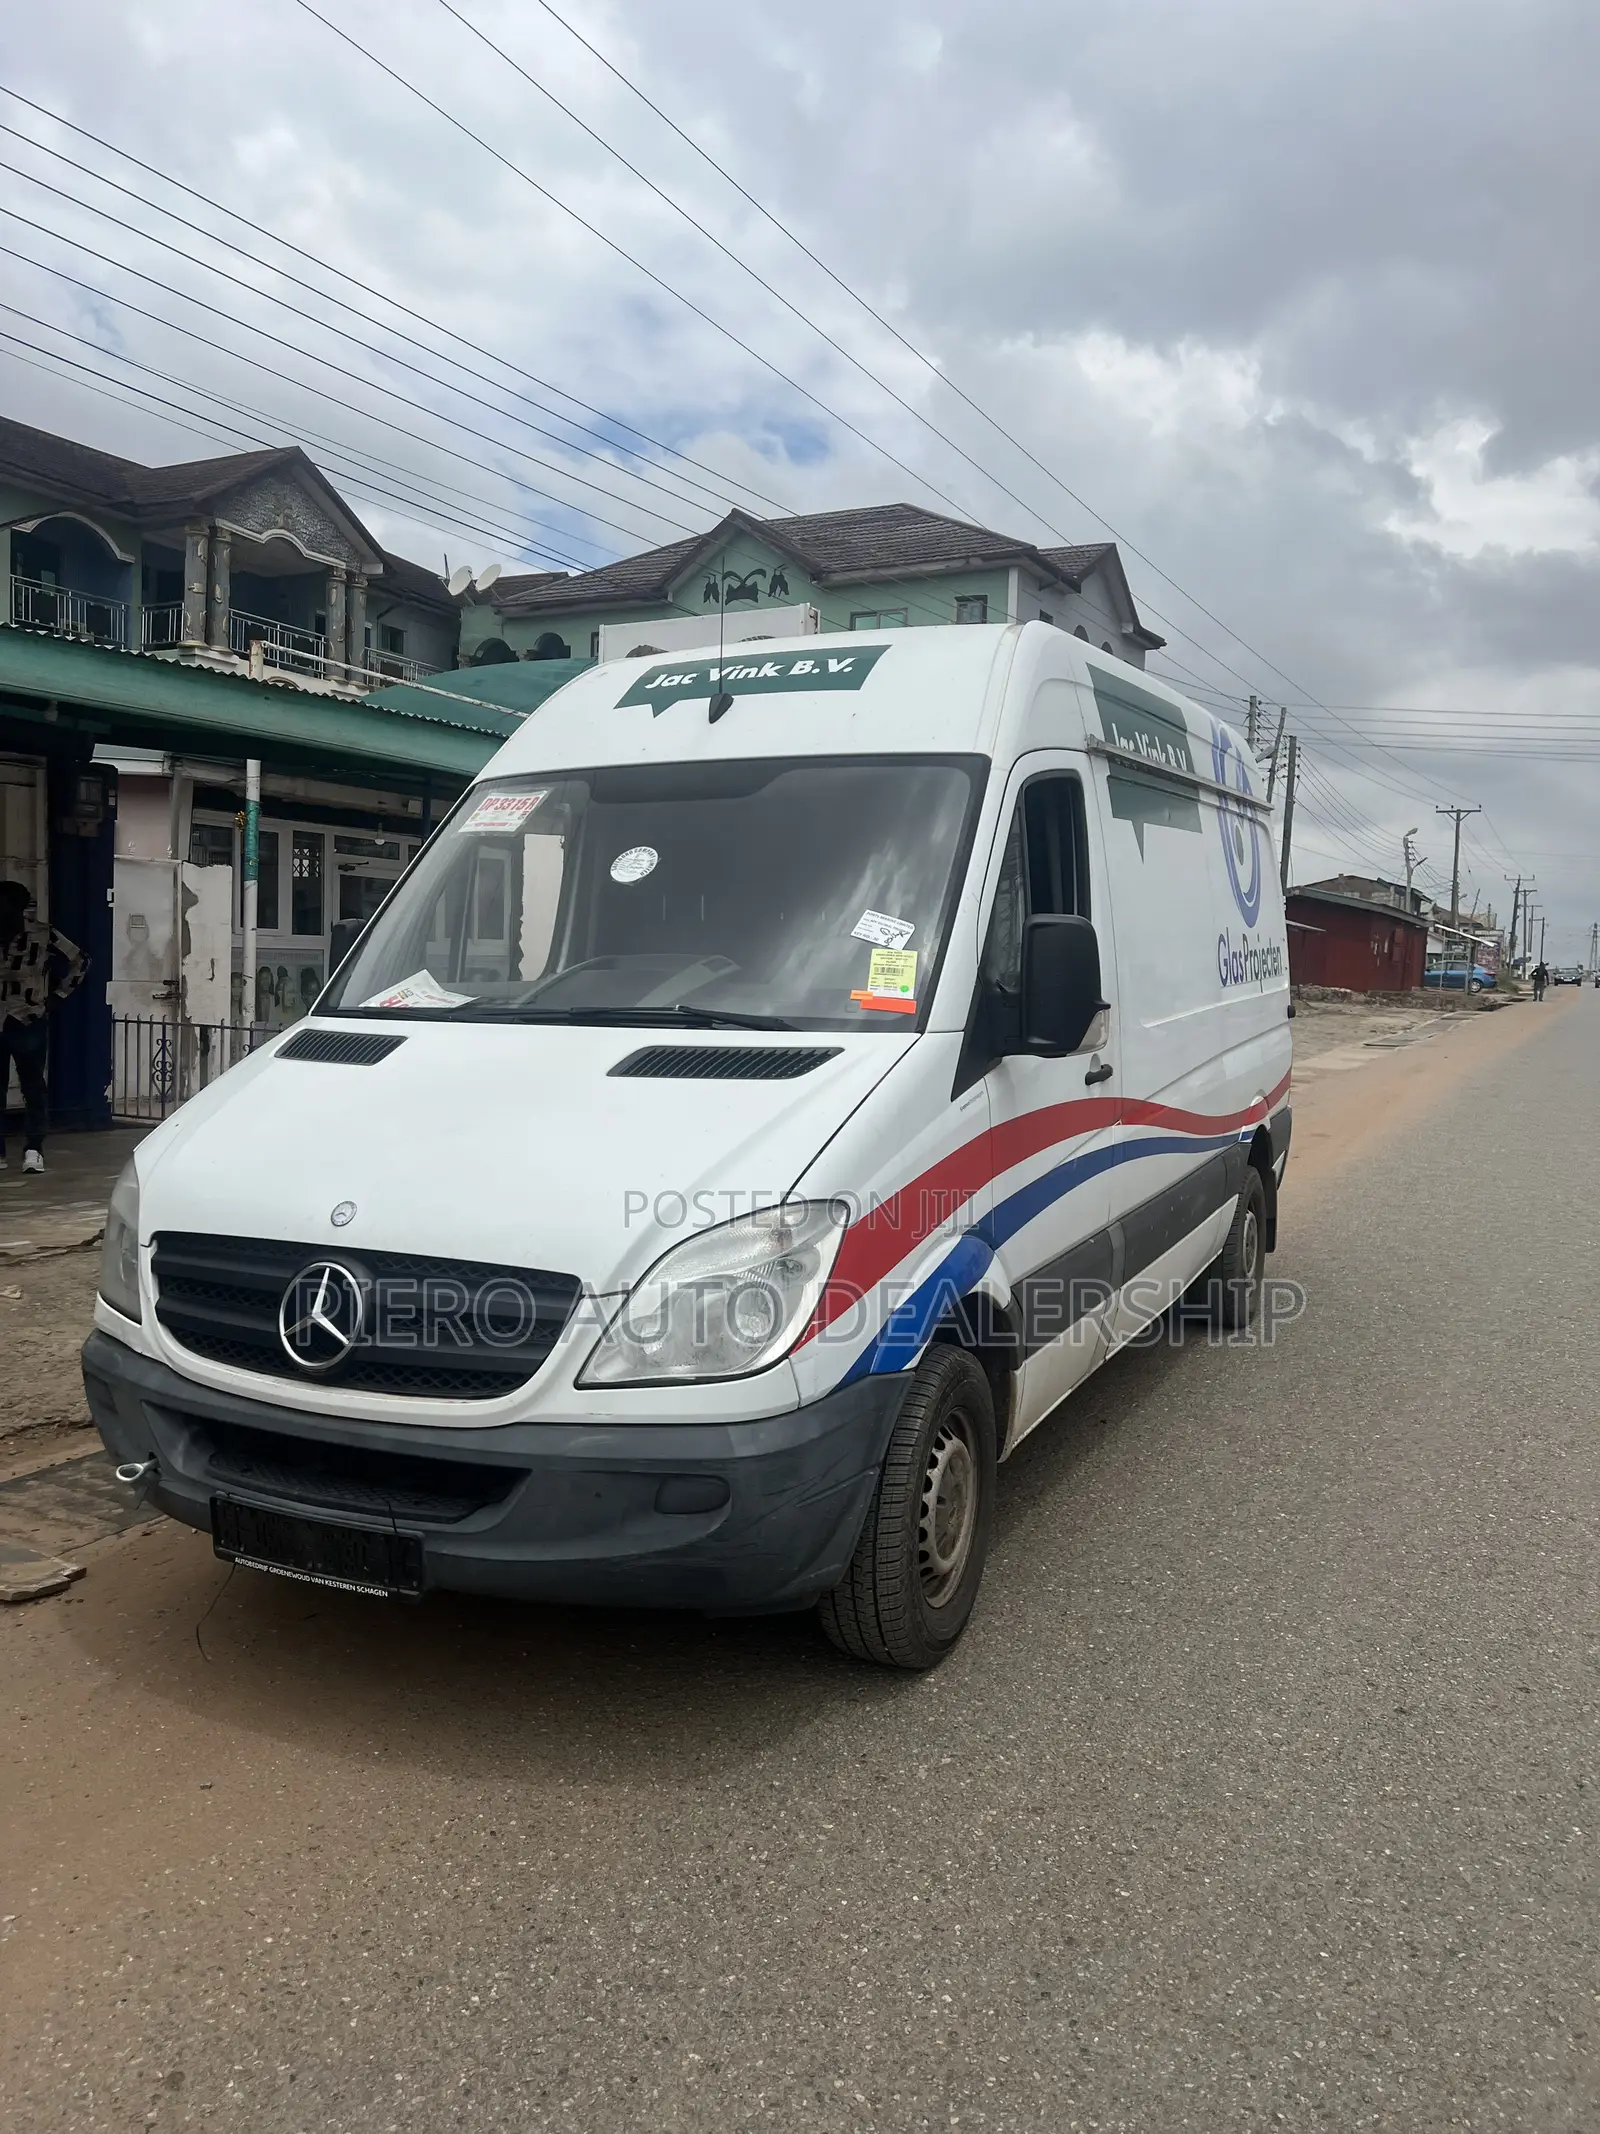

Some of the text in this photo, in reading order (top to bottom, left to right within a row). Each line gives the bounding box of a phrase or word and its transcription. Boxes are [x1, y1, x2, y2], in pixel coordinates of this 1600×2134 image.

[645, 657, 857, 690] Jac Vink B.V.
[1218, 927, 1283, 993] GlasProjecten
[234, 1557, 388, 1598] AUTOBEDRIJF GROENEWOUD VAN KESTEREN SCHAGEN
